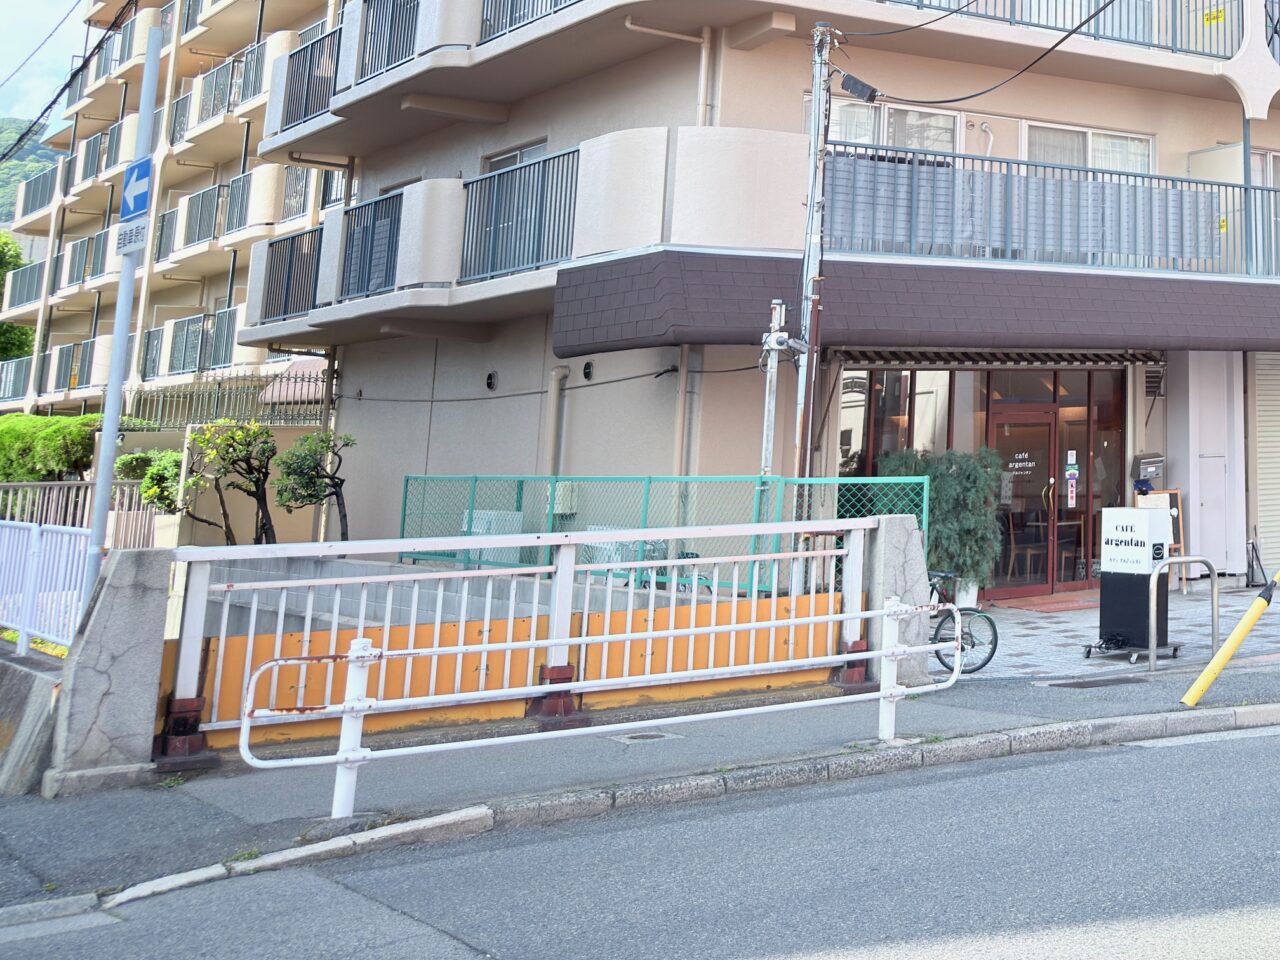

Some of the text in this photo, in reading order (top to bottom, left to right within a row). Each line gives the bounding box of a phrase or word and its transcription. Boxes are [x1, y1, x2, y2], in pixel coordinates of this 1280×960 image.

[1014, 451, 1029, 459] café
[1115, 523, 1136, 533] CAFÉ
[1104, 537, 1146, 547] argentan
